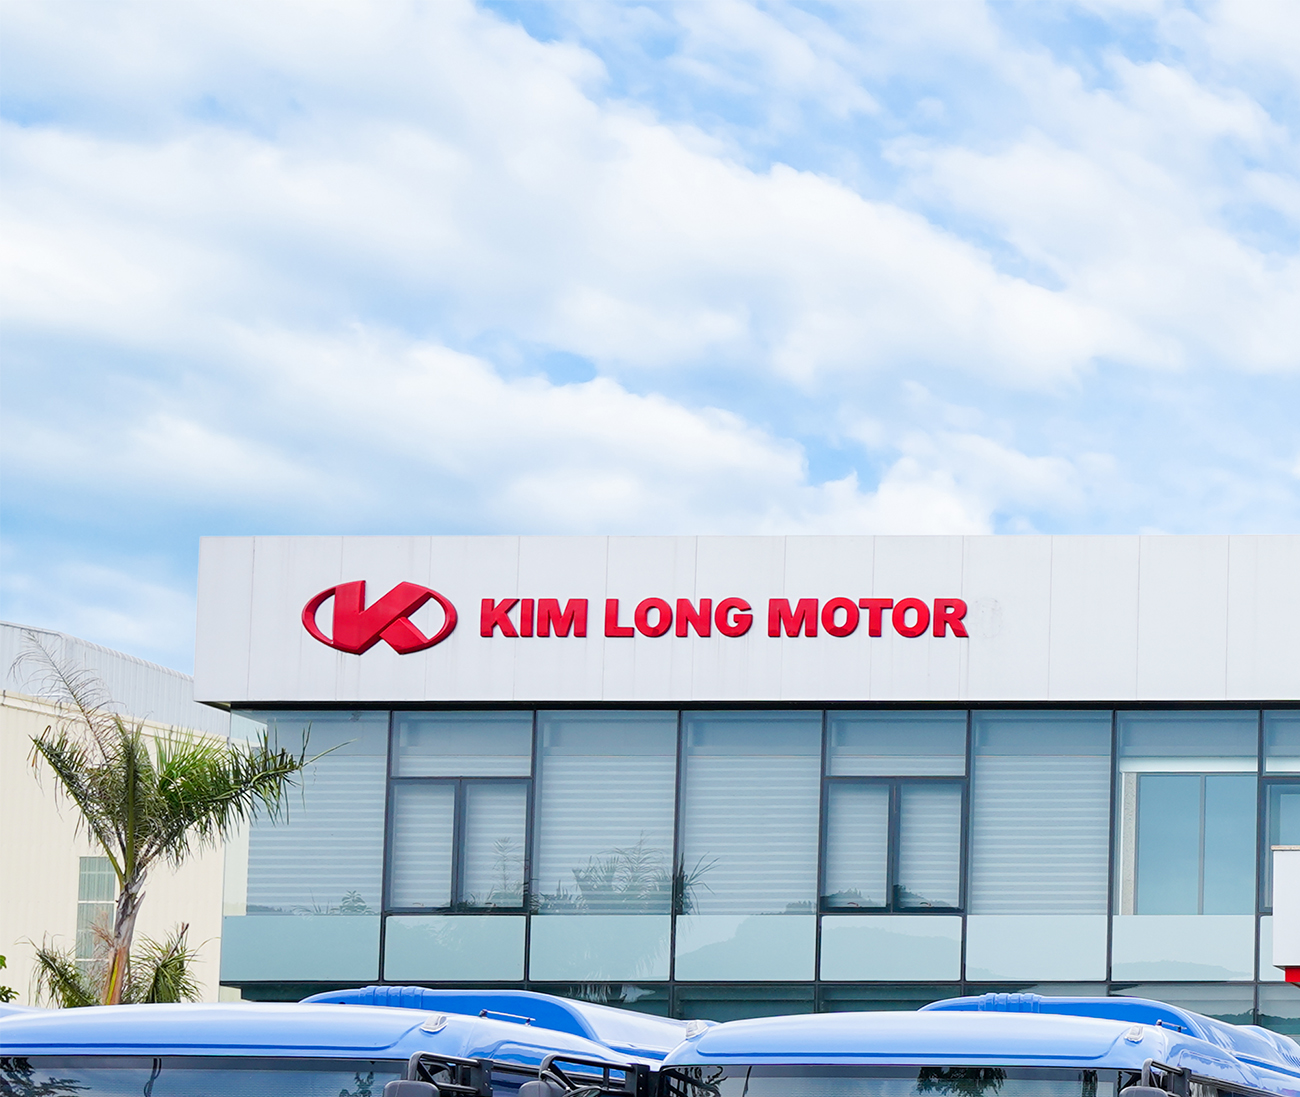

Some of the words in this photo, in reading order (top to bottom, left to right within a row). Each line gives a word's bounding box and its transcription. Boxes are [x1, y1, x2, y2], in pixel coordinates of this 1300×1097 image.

[480, 597, 588, 638] KIM
[604, 597, 753, 639] LONG
[767, 597, 969, 639] MOTOR
